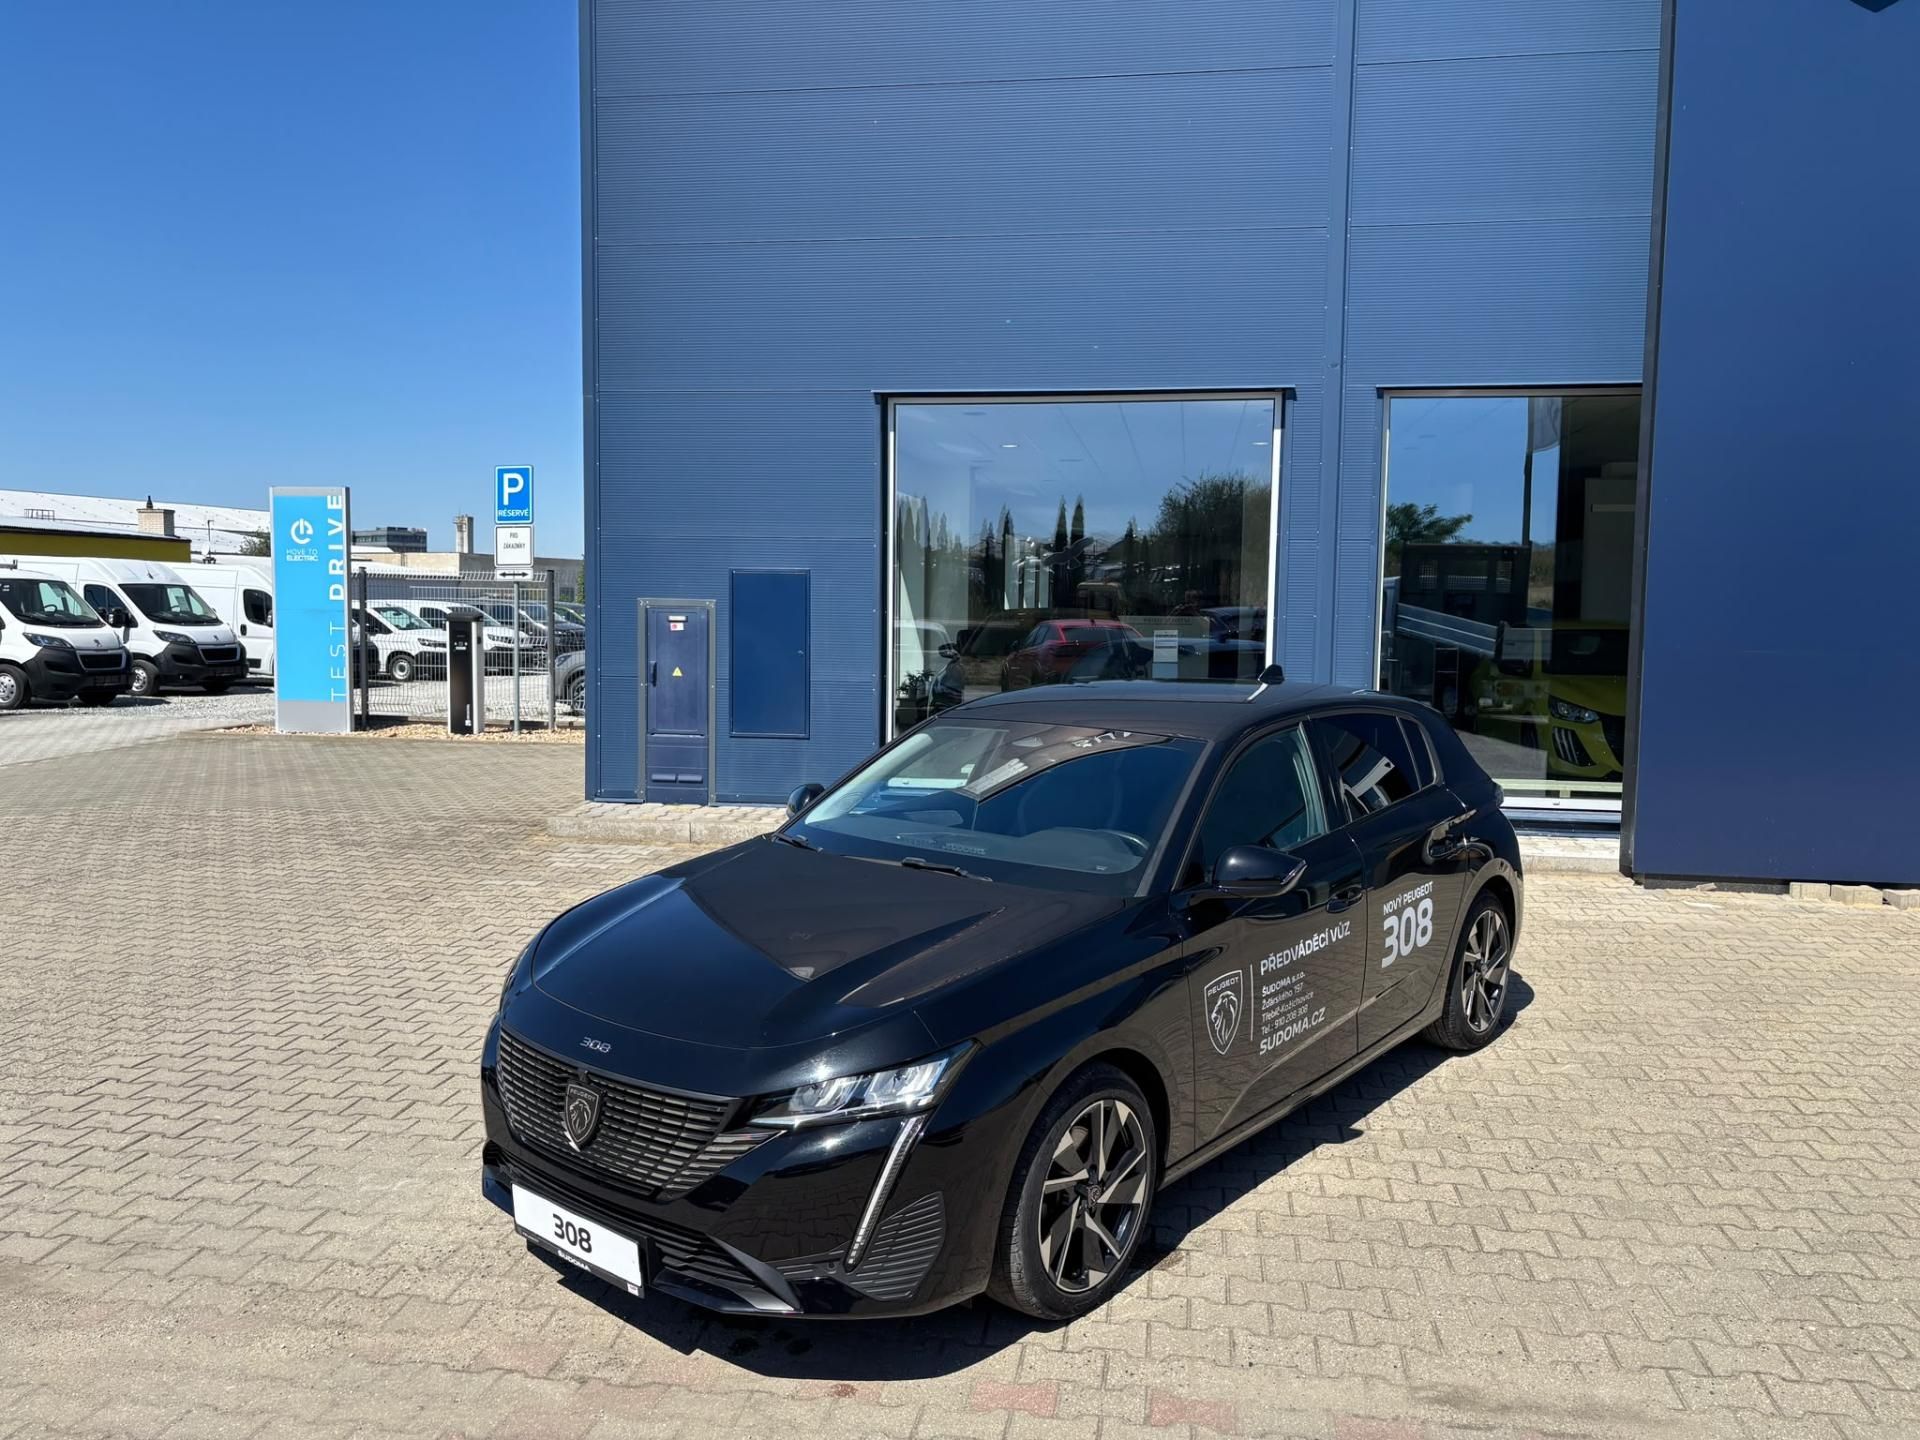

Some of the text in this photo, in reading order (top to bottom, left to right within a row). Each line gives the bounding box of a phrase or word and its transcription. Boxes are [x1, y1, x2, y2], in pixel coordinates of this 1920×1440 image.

[503, 472, 524, 506] P
[327, 494, 346, 702] TEST DRIVE
[1383, 881, 1433, 915] NOVÝ PEUGEOT
[1260, 921, 1351, 975] PŘEDVÁDĚCÍ VŮZ
[1381, 898, 1433, 968] 308
[1207, 976, 1239, 997] PEUGEOT
[1259, 1006, 1327, 1056] SUDOMA.CZ
[1275, 1016, 1285, 1029] 910
[579, 1036, 611, 1054] 308
[552, 1213, 592, 1253] 308
